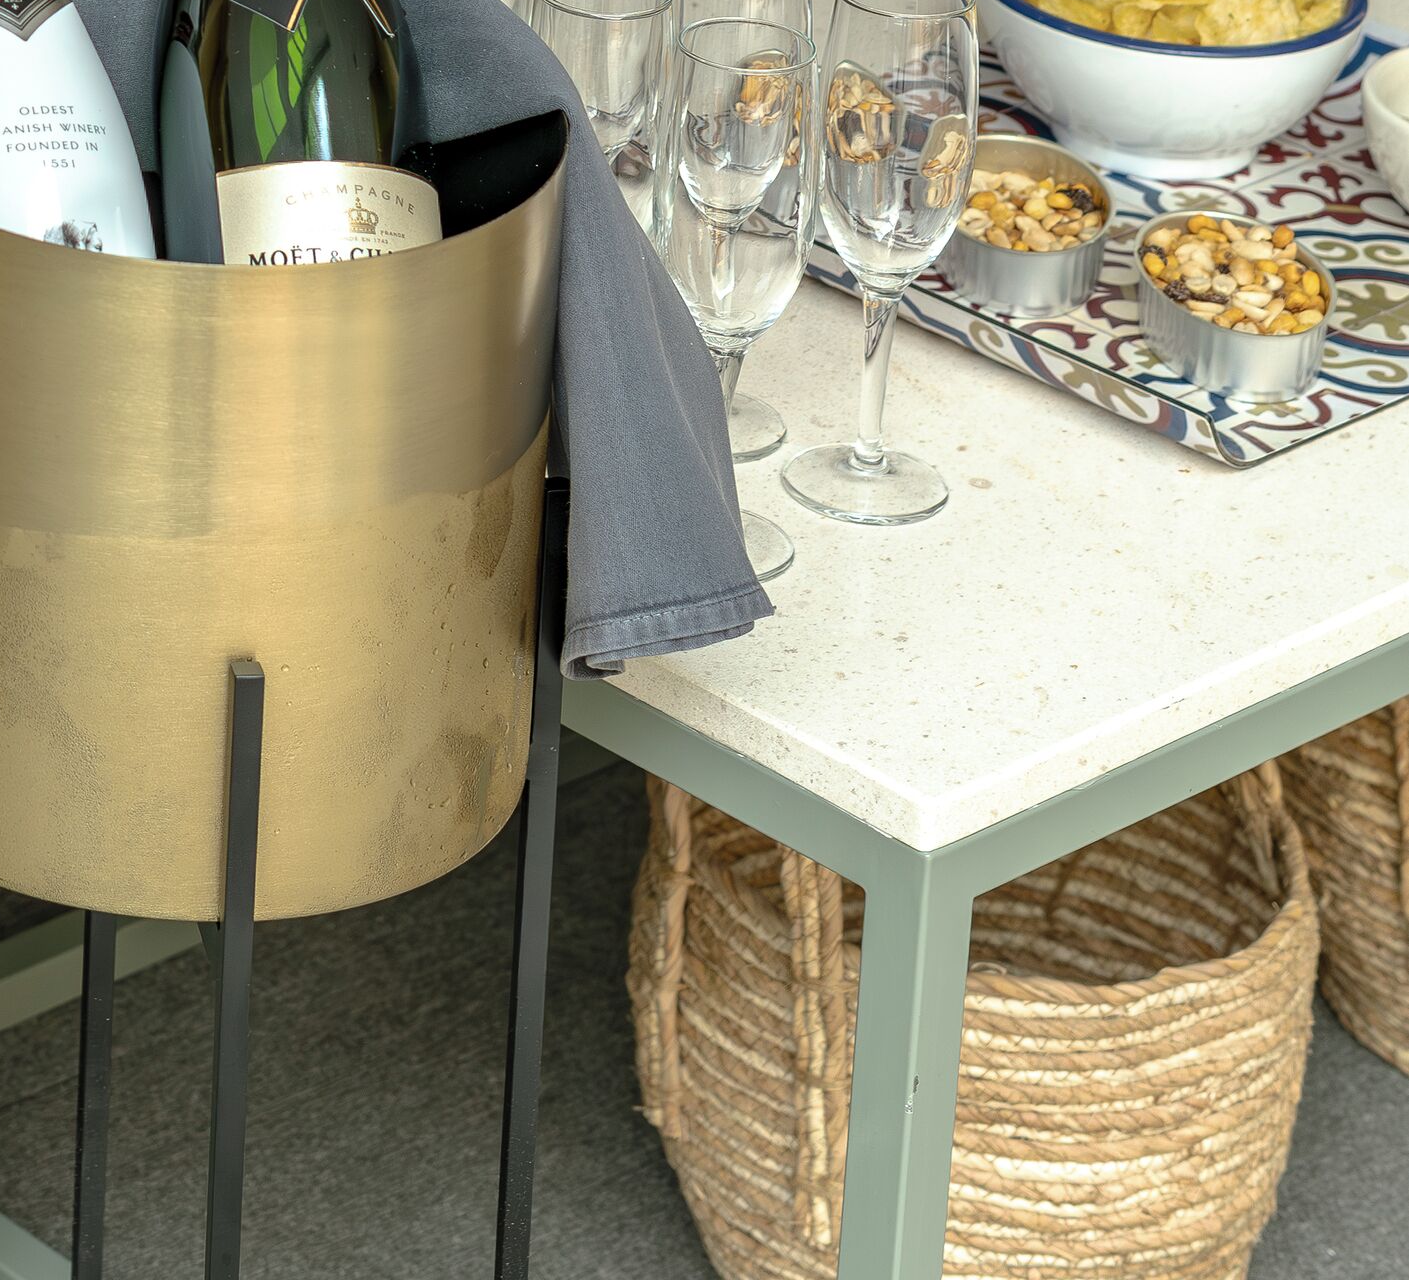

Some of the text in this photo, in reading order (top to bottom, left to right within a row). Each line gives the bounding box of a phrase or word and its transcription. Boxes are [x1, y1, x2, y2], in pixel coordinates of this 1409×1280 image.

[19, 105, 74, 116] OLDEST
[59, 123, 106, 135] WINERY
[6, 141, 99, 152] FOUNDED IN
[43, 159, 76, 168] 1551
[248, 245, 321, 266] MOËT
[329, 250, 342, 264] &
